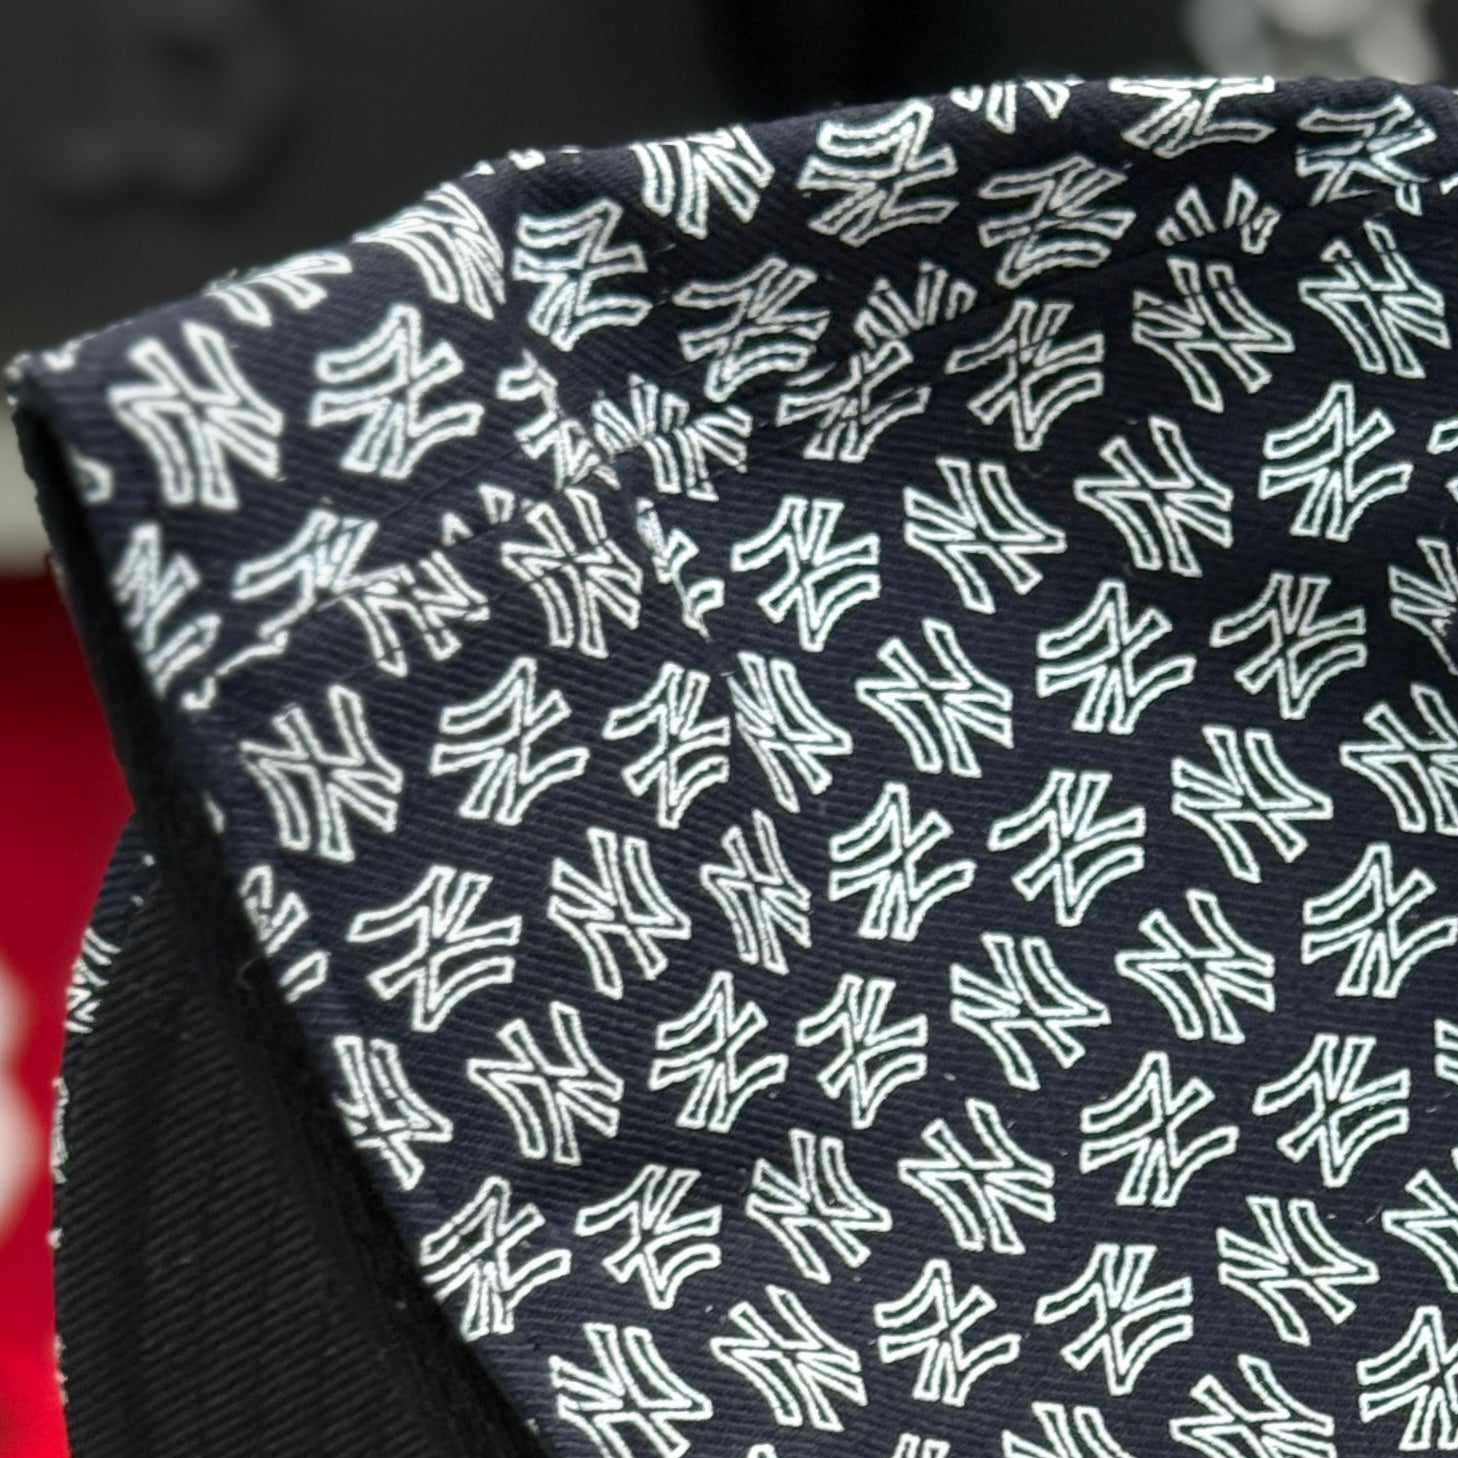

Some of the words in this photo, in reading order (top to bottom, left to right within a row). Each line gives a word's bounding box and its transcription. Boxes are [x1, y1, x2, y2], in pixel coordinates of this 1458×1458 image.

[799, 100, 956, 244] NY
[981, 158, 1134, 286] NY
[512, 198, 652, 350] NY
[673, 255, 830, 402] NY
[1134, 260, 1293, 411] NY
[1301, 223, 1449, 376] NY
[109, 320, 284, 509] NY
[309, 304, 483, 478] NY
[948, 301, 1102, 449] NY
[905, 458, 1065, 612] NY
[1076, 418, 1232, 575] NY
[1260, 384, 1412, 540] NY
[500, 490, 642, 660] NY
[732, 497, 880, 650] NY
[1212, 575, 1365, 718] NY
[729, 655, 852, 808] NY
[857, 619, 1012, 776] NY
[1038, 581, 1195, 733] NY
[242, 685, 402, 861] NY
[430, 658, 588, 824] NY
[602, 663, 730, 823] NY
[1173, 727, 1332, 881] NY
[548, 828, 690, 998] NY
[701, 811, 811, 973] NY
[830, 783, 975, 940] NY
[989, 770, 1144, 925] NY
[1303, 844, 1458, 996] NY
[348, 866, 520, 1031] NY
[951, 934, 1109, 1089] NY
[1116, 890, 1274, 1042] NY
[468, 1002, 622, 1164] NY
[649, 972, 787, 1131] NY
[796, 975, 926, 1127] NY
[1254, 1035, 1409, 1186] NY
[899, 1100, 1054, 1253] NY
[1081, 1053, 1237, 1205] NY
[574, 1166, 720, 1308] NY
[747, 1130, 891, 1282] NY
[1218, 1197, 1378, 1345] NY
[711, 1286, 866, 1430] NY
[871, 1260, 1027, 1405] NY
[1036, 1244, 1192, 1394] NY
